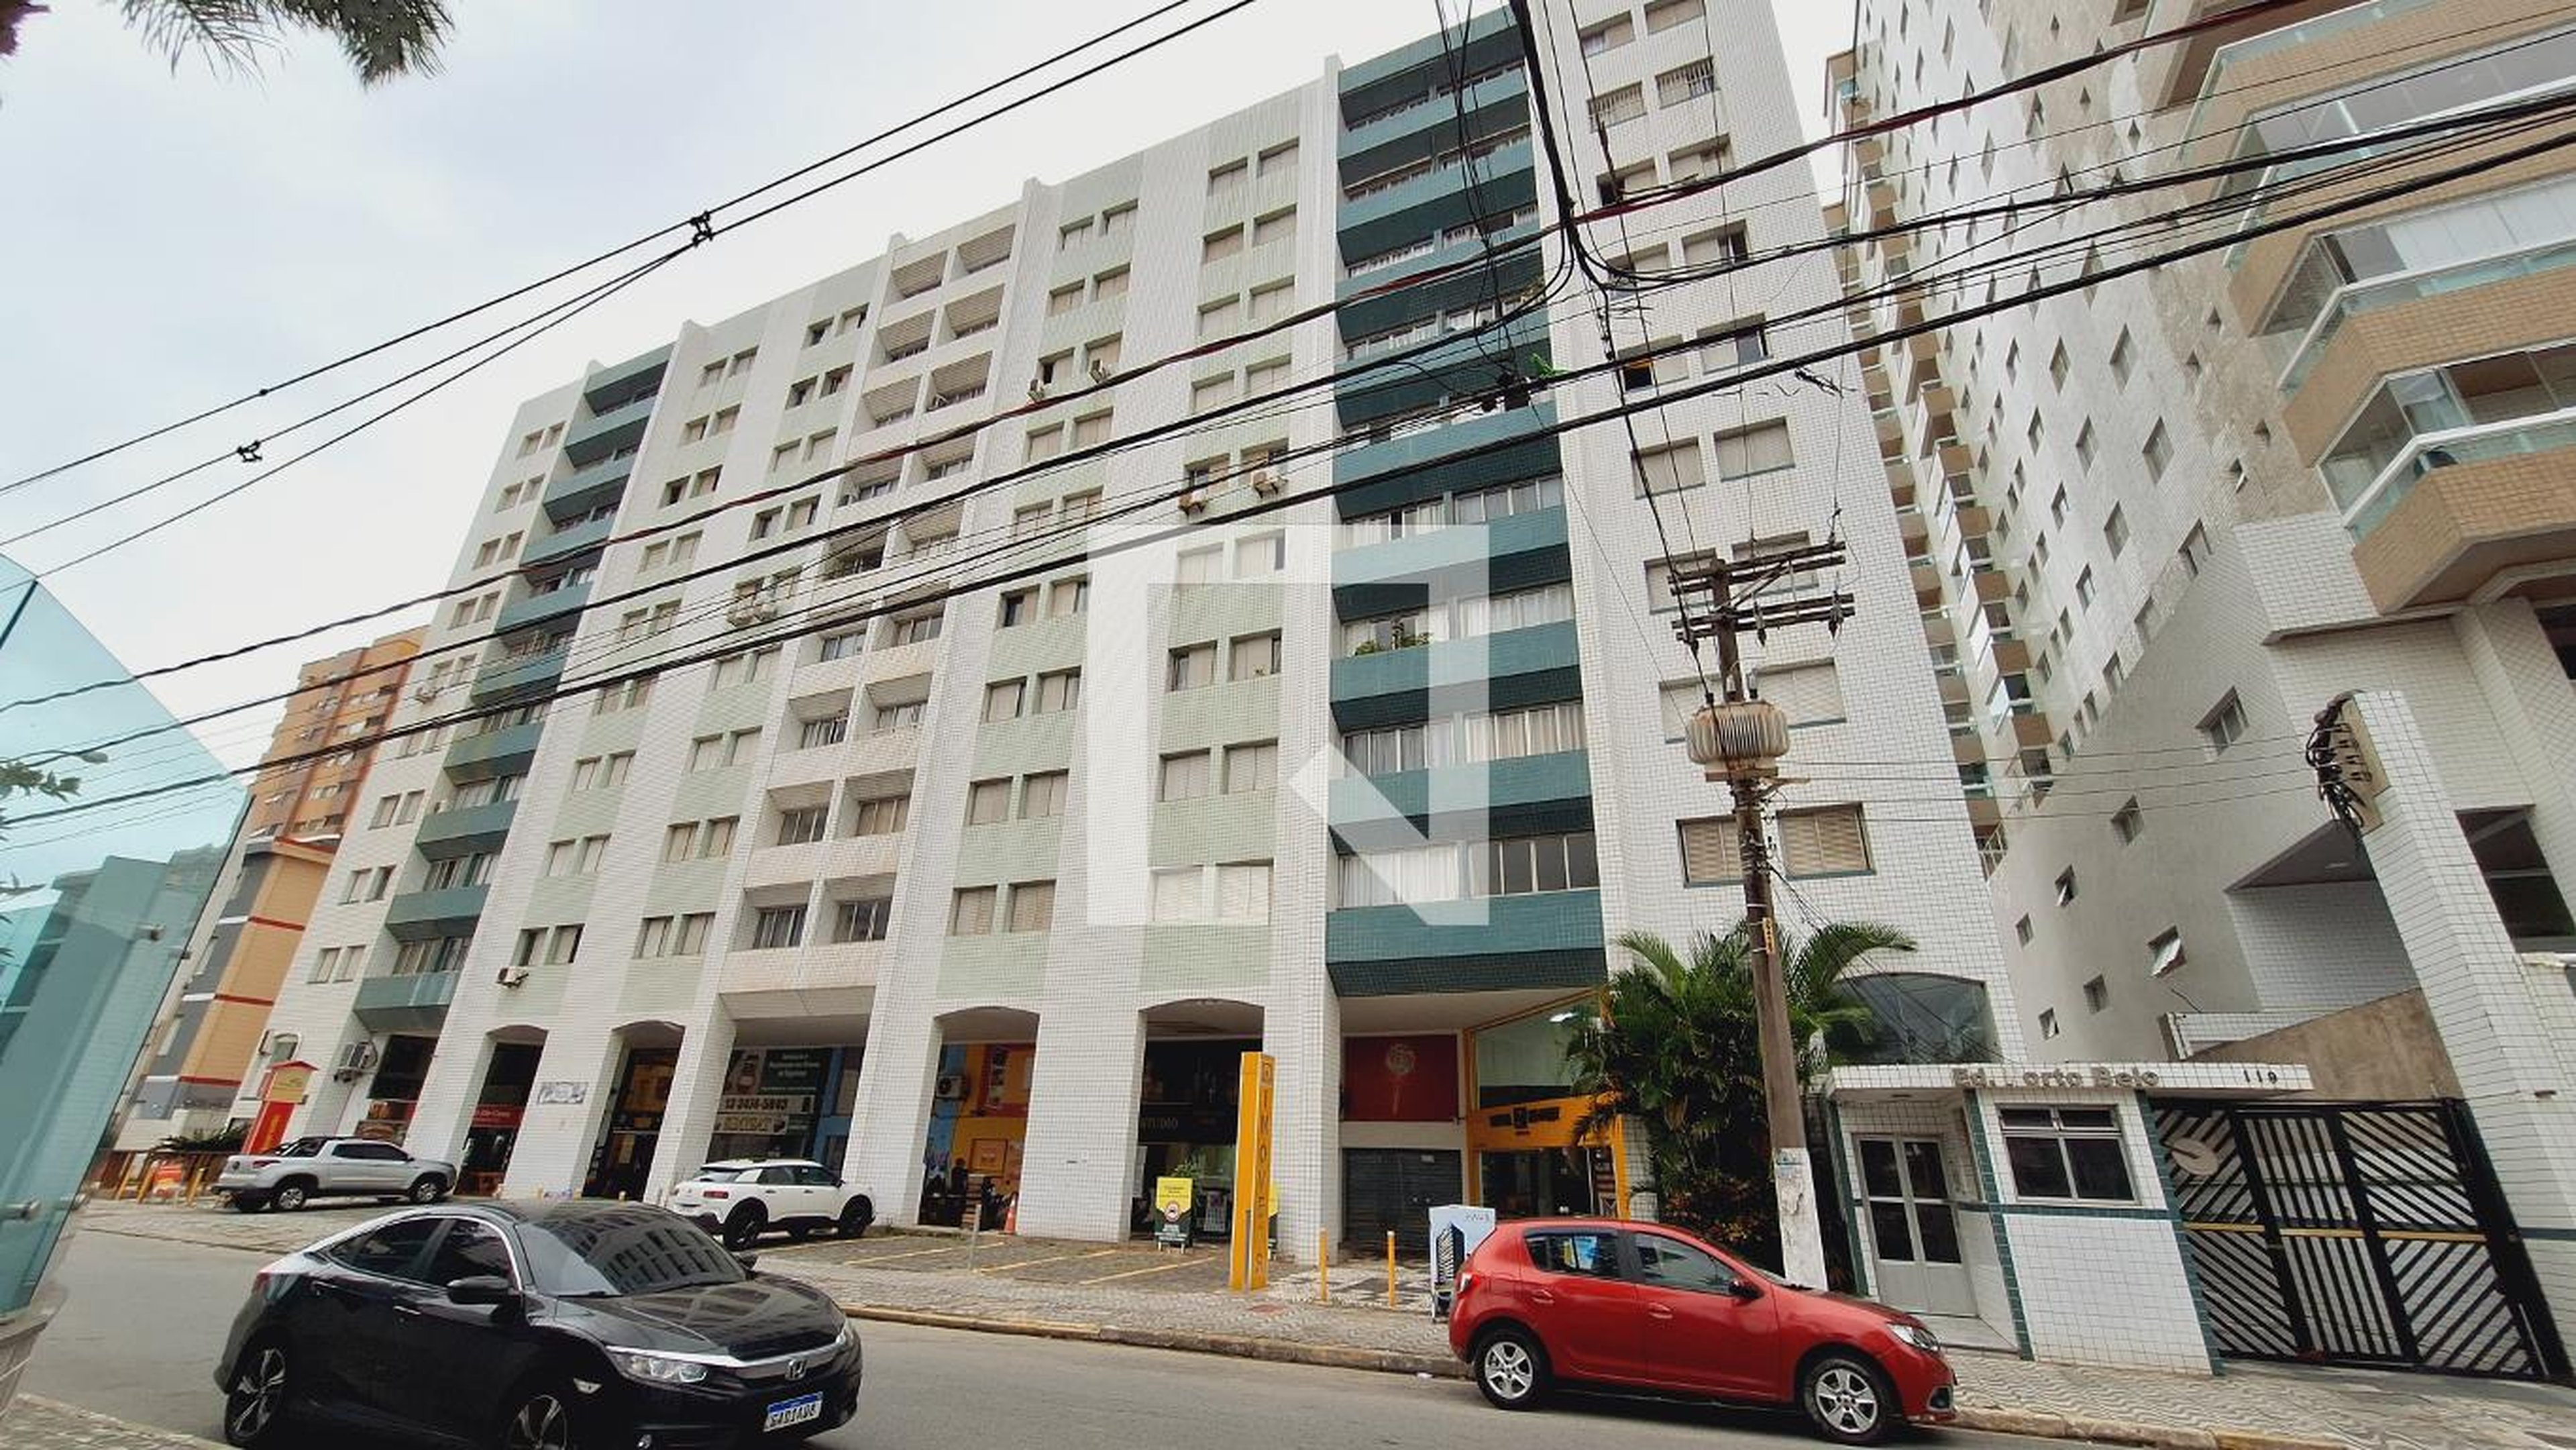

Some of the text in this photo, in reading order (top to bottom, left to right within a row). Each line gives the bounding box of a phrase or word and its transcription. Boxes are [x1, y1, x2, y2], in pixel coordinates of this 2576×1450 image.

[1953, 1066, 2159, 1088] Ed. orto Belo
